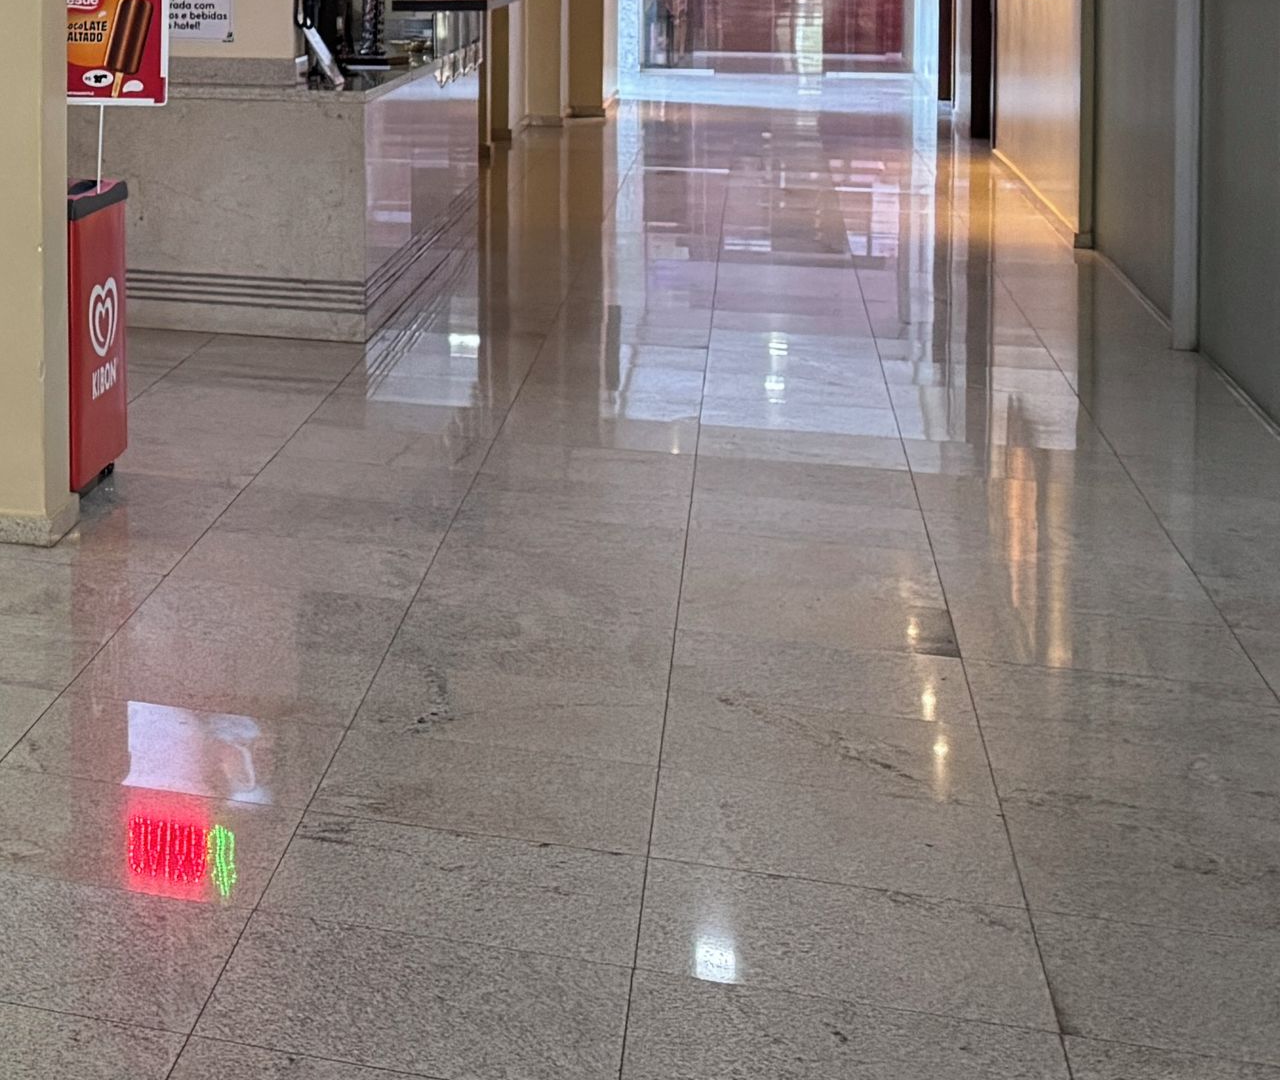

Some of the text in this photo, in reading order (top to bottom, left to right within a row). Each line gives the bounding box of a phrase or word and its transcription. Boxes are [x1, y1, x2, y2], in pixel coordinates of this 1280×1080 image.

[169, 1, 192, 10] rada
[190, 11, 228, 20] bebidas
[67, 21, 108, 32] ocoLATE
[67, 32, 103, 43] ALTADO
[92, 357, 117, 400] KIBON
